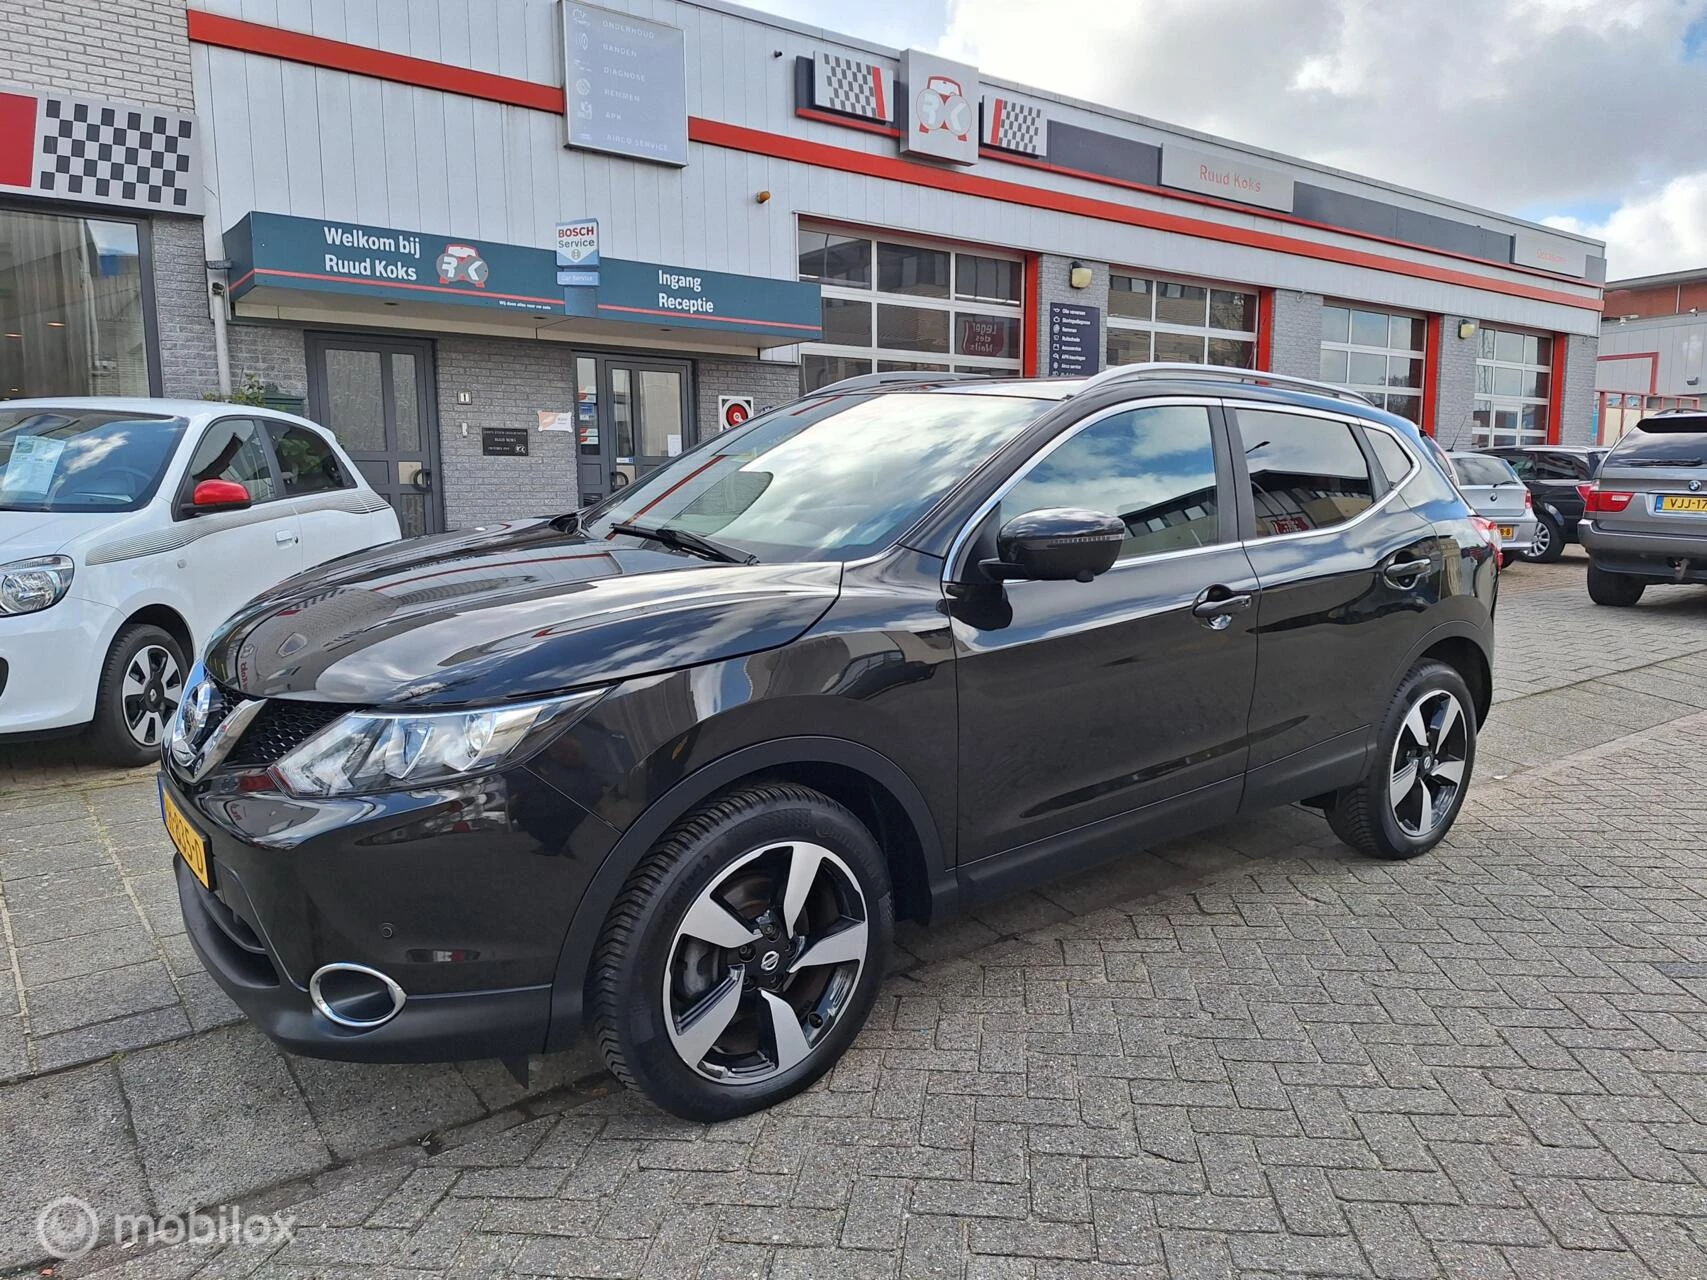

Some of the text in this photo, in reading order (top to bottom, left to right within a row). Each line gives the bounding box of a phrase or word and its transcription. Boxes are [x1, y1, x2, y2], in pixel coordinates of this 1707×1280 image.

[634, 137, 669, 152] SERVICE
[1200, 164, 1262, 193] Ruud Koks
[324, 226, 421, 259] Welkom bij
[558, 226, 594, 238] BOSCH
[558, 238, 595, 249] Service
[324, 254, 417, 280] Ruud Koks
[658, 269, 702, 292] Ingang
[658, 292, 714, 314] Receptie
